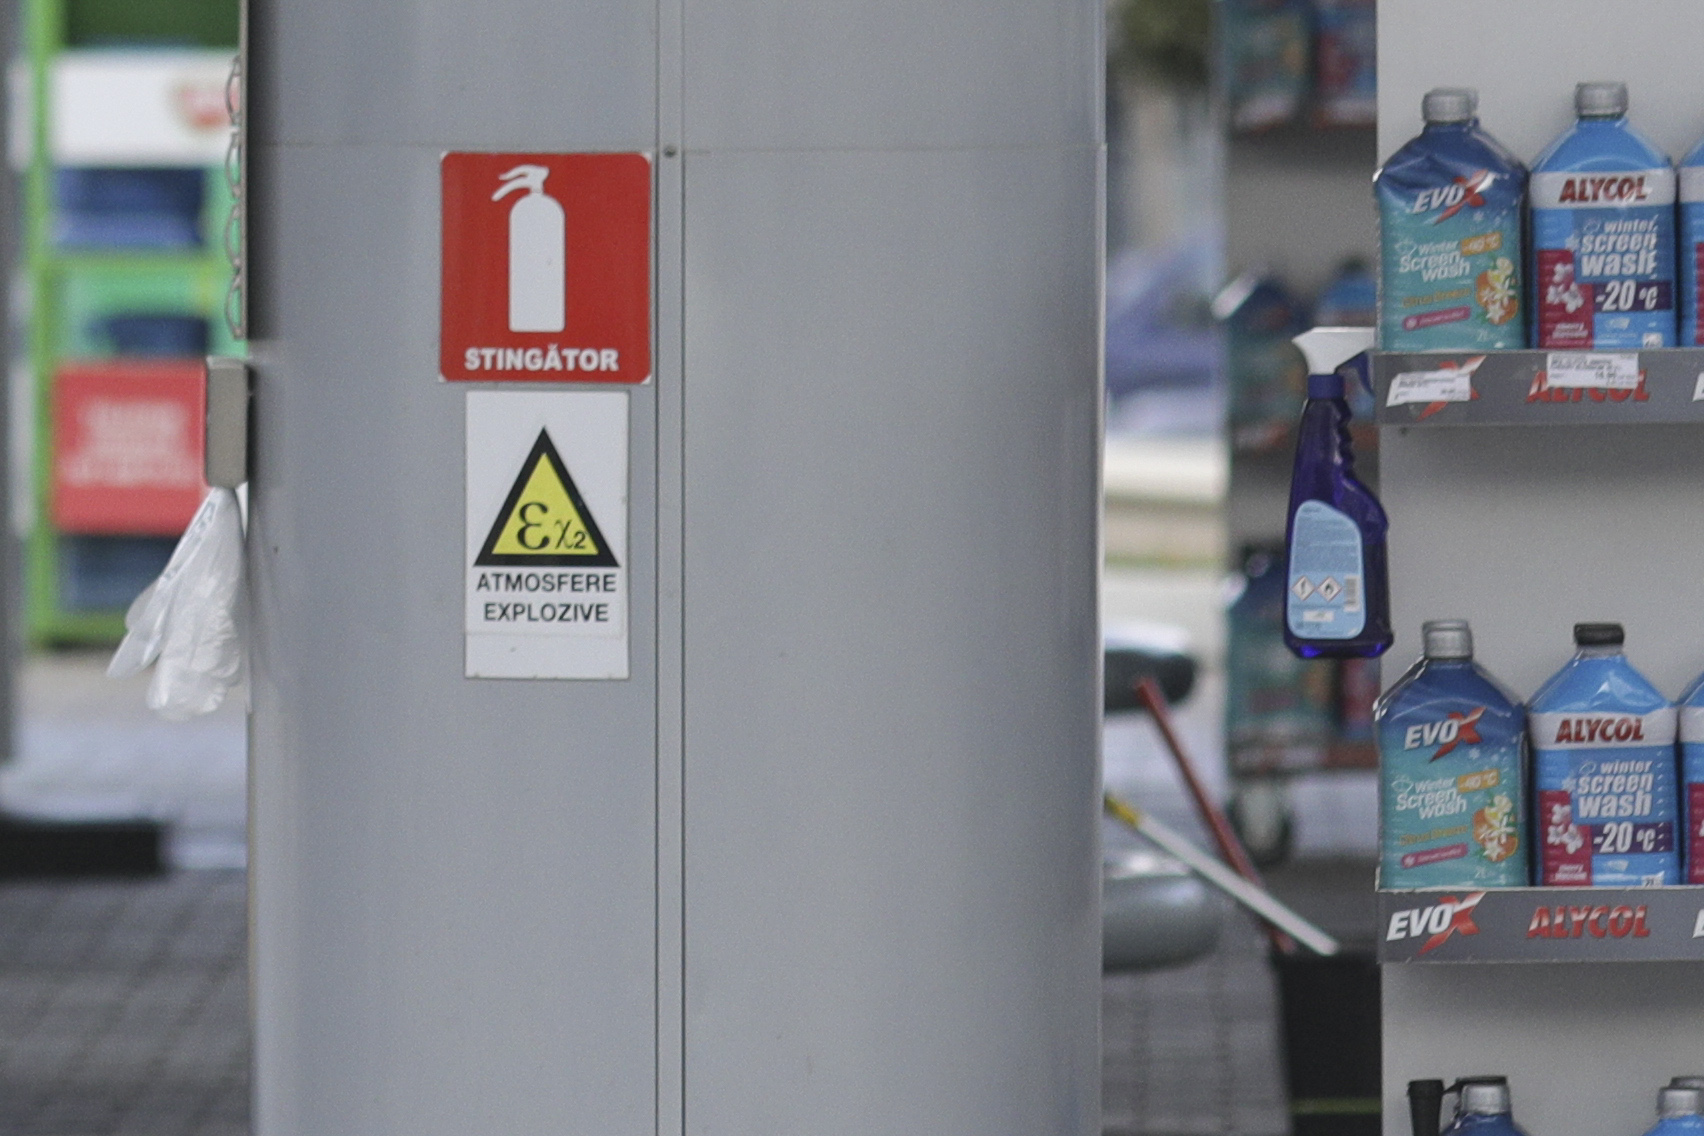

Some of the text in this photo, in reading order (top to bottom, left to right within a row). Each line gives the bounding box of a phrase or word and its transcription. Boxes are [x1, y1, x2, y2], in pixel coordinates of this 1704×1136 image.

[1558, 176, 1648, 204] ALYCOL
[1581, 232, 1658, 253] screen
[1398, 250, 1462, 274] Screen
[1422, 258, 1471, 282] wash
[1581, 249, 1656, 277] wash
[1595, 280, 1636, 311] -20
[464, 344, 620, 373] STINGĂTOR
[475, 572, 617, 593] ATMOSFERE
[483, 602, 610, 623] EXPLOZIVE
[1404, 706, 1486, 763] EVOX
[1554, 717, 1645, 744] ALYCOL
[1600, 758, 1653, 774] winter
[1576, 773, 1653, 794] screen
[1395, 787, 1458, 811] Screen
[1419, 794, 1468, 820] wash
[1577, 790, 1653, 819] wash
[1594, 821, 1634, 853] -20
[1385, 891, 1652, 955] EVOX ALYCOL
